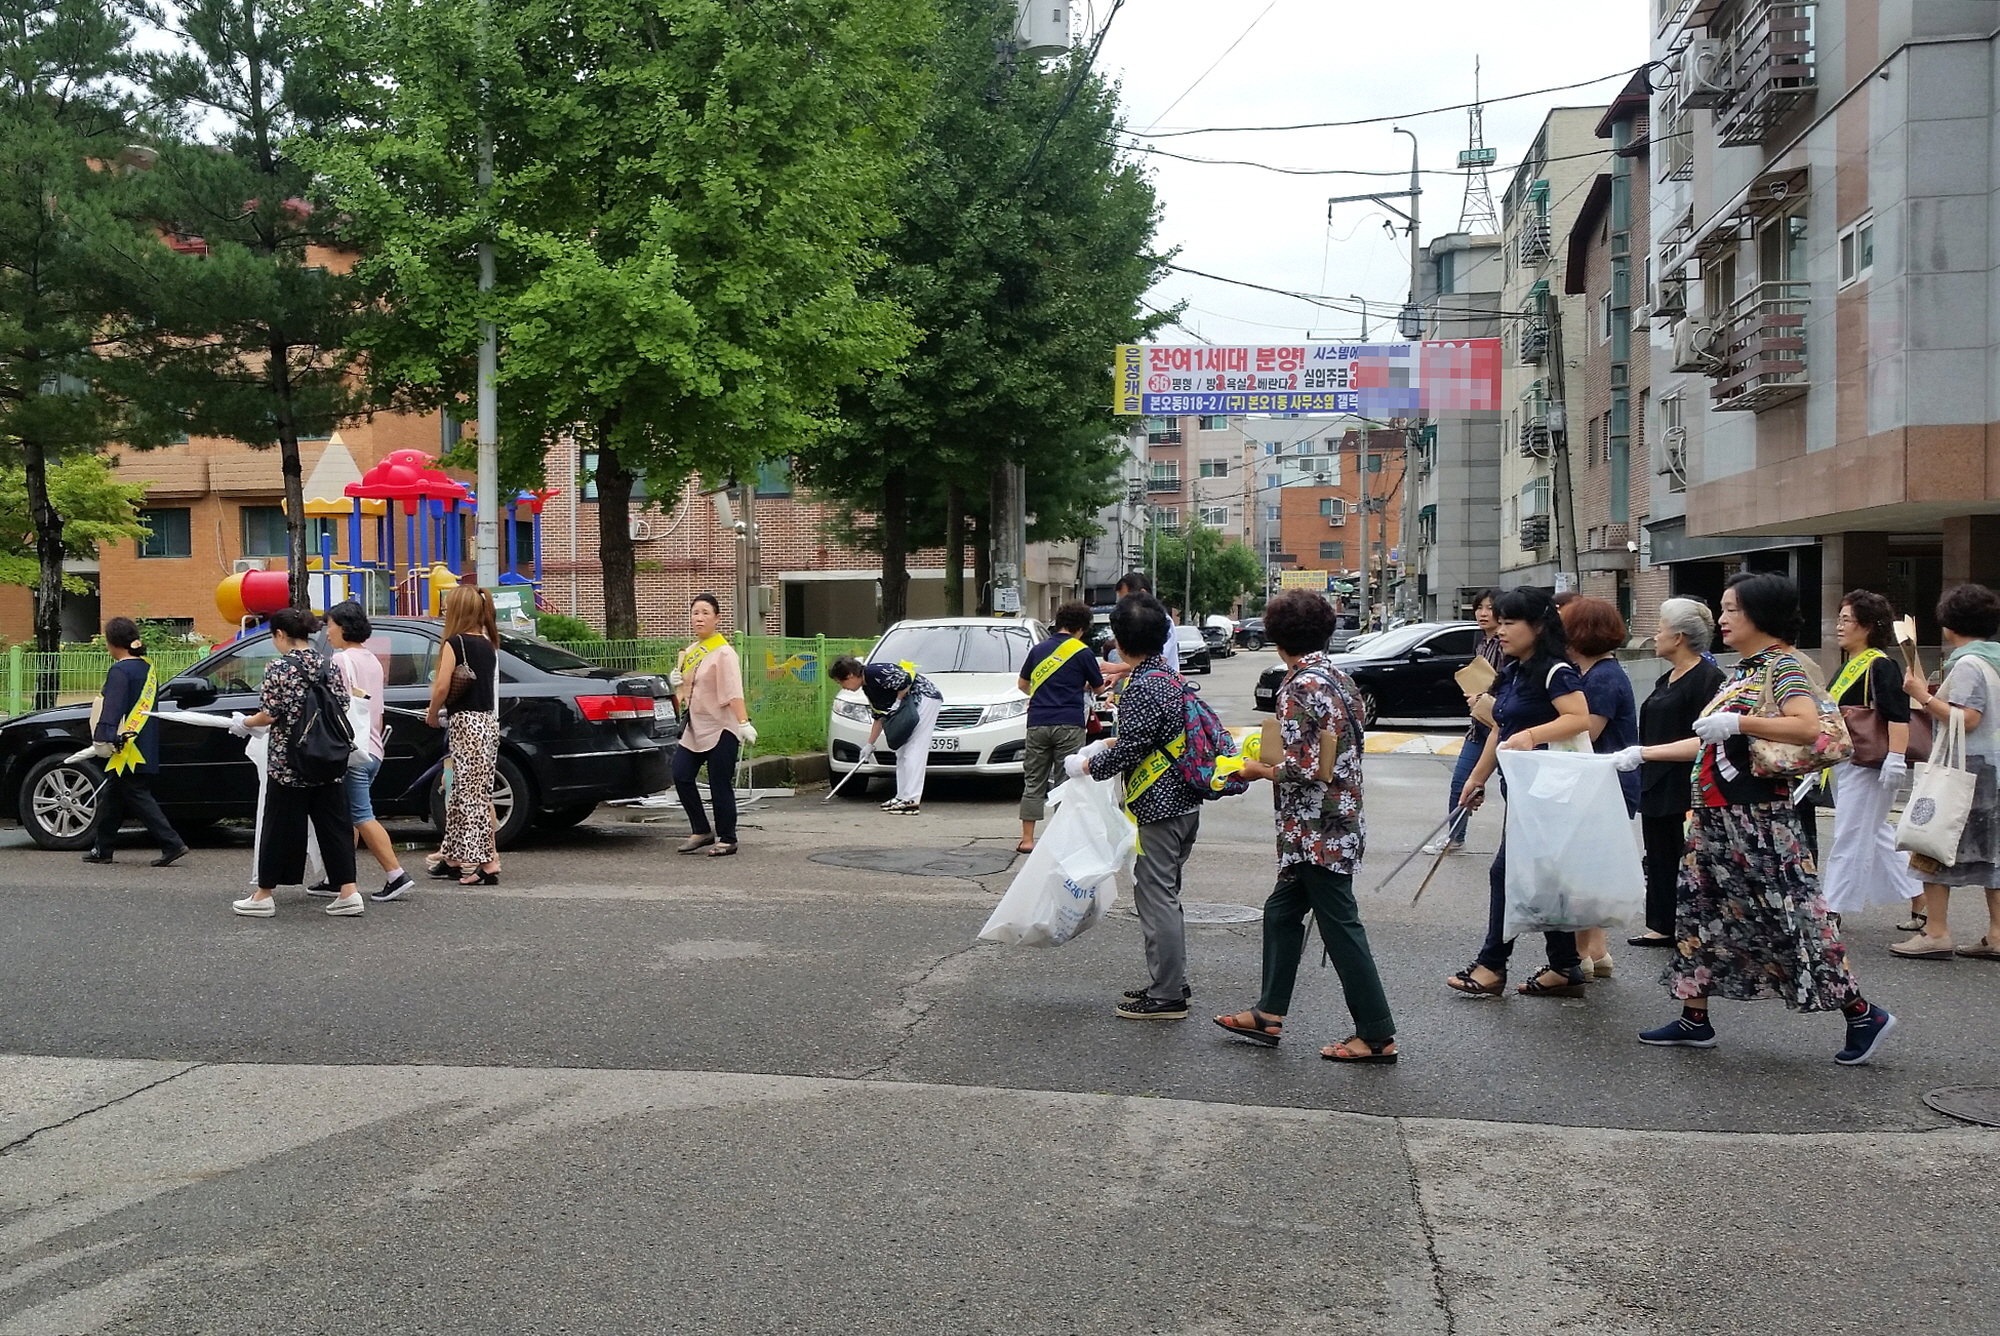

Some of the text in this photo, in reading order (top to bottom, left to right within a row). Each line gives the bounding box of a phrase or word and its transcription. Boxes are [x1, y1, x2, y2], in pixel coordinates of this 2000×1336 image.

[1149, 346, 1306, 372] 잔여1세대 분양!
[1124, 347, 1141, 412] 은성캐슬
[1304, 368, 1348, 388] 실입주금
[1150, 395, 1217, 412] 본오동918-2
[1248, 394, 1288, 411] 본오1동
[1290, 393, 1335, 410] 사무소옆
